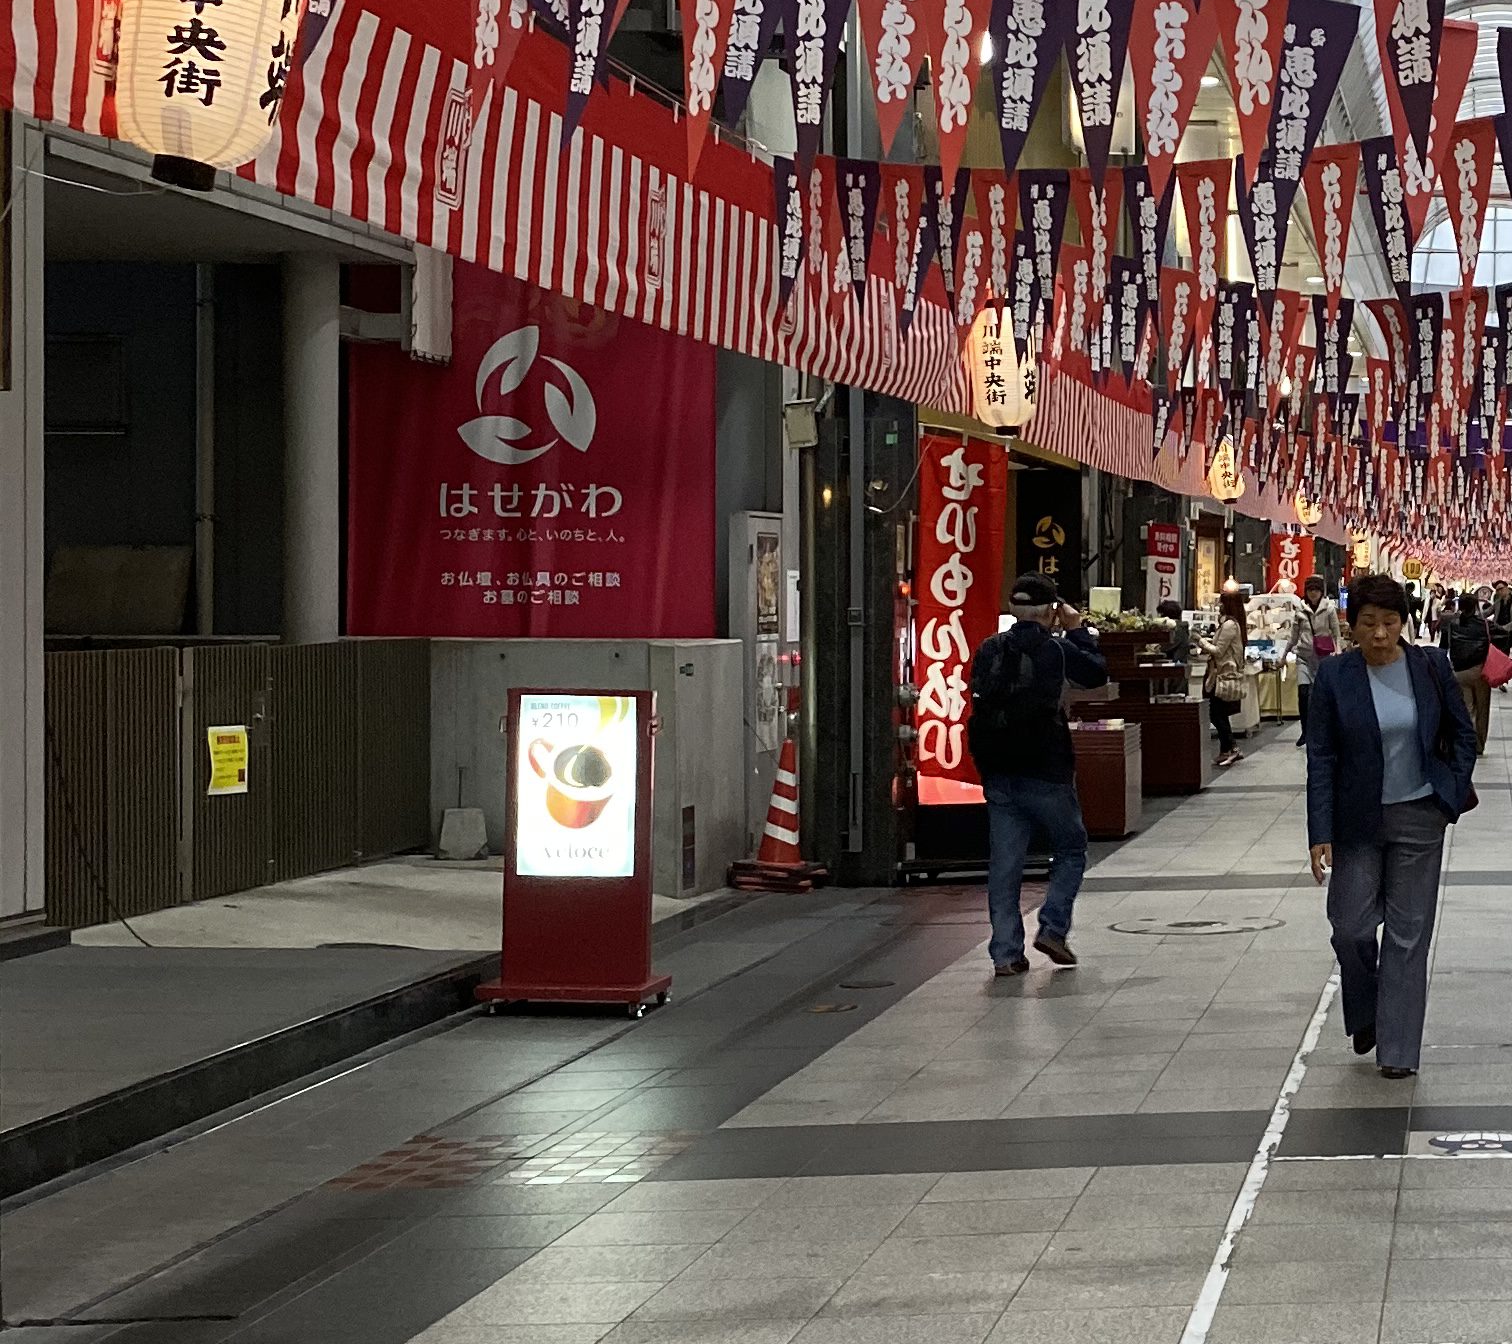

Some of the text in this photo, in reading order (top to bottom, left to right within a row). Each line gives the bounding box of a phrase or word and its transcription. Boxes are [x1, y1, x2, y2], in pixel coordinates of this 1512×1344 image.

[1147, 2, 1188, 157] せいもん払い
[1275, 46, 1317, 181] 恵比須講
[1454, 139, 1478, 274] せいもん払い
[982, 324, 1007, 407] 川端中央街
[440, 483, 623, 518] はせがわ
